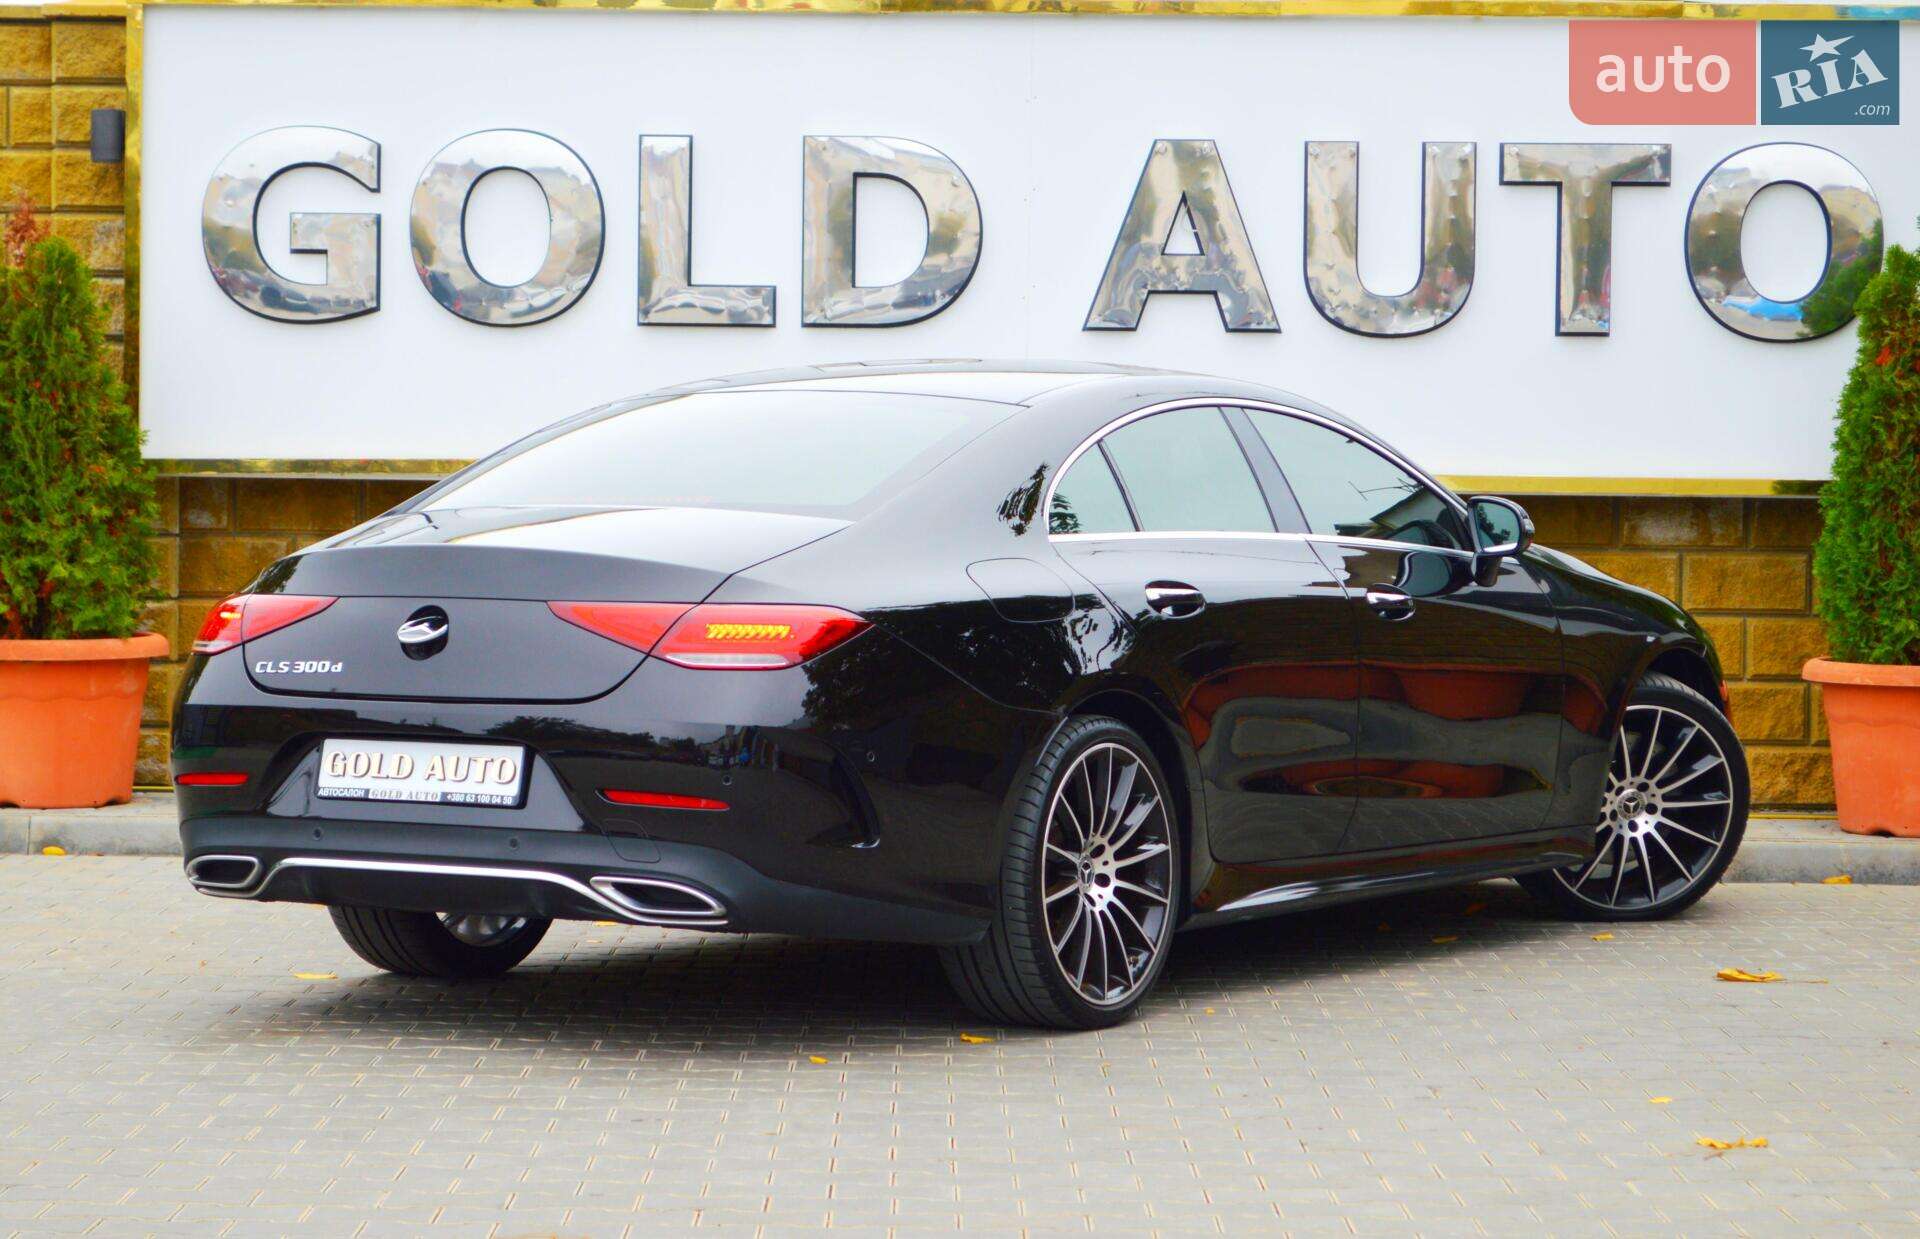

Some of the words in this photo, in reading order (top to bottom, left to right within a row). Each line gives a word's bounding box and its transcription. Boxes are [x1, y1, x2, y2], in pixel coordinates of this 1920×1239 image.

[201, 125, 983, 328] GOLD
[1083, 138, 1885, 343] AUTO
[255, 661, 290, 673] CLS
[324, 751, 414, 780] GOLD
[424, 755, 517, 785] AUTO
[318, 788, 365, 797] АВТОСАЛОН
[371, 788, 402, 799] GOLD
[406, 791, 439, 801] AUTO
